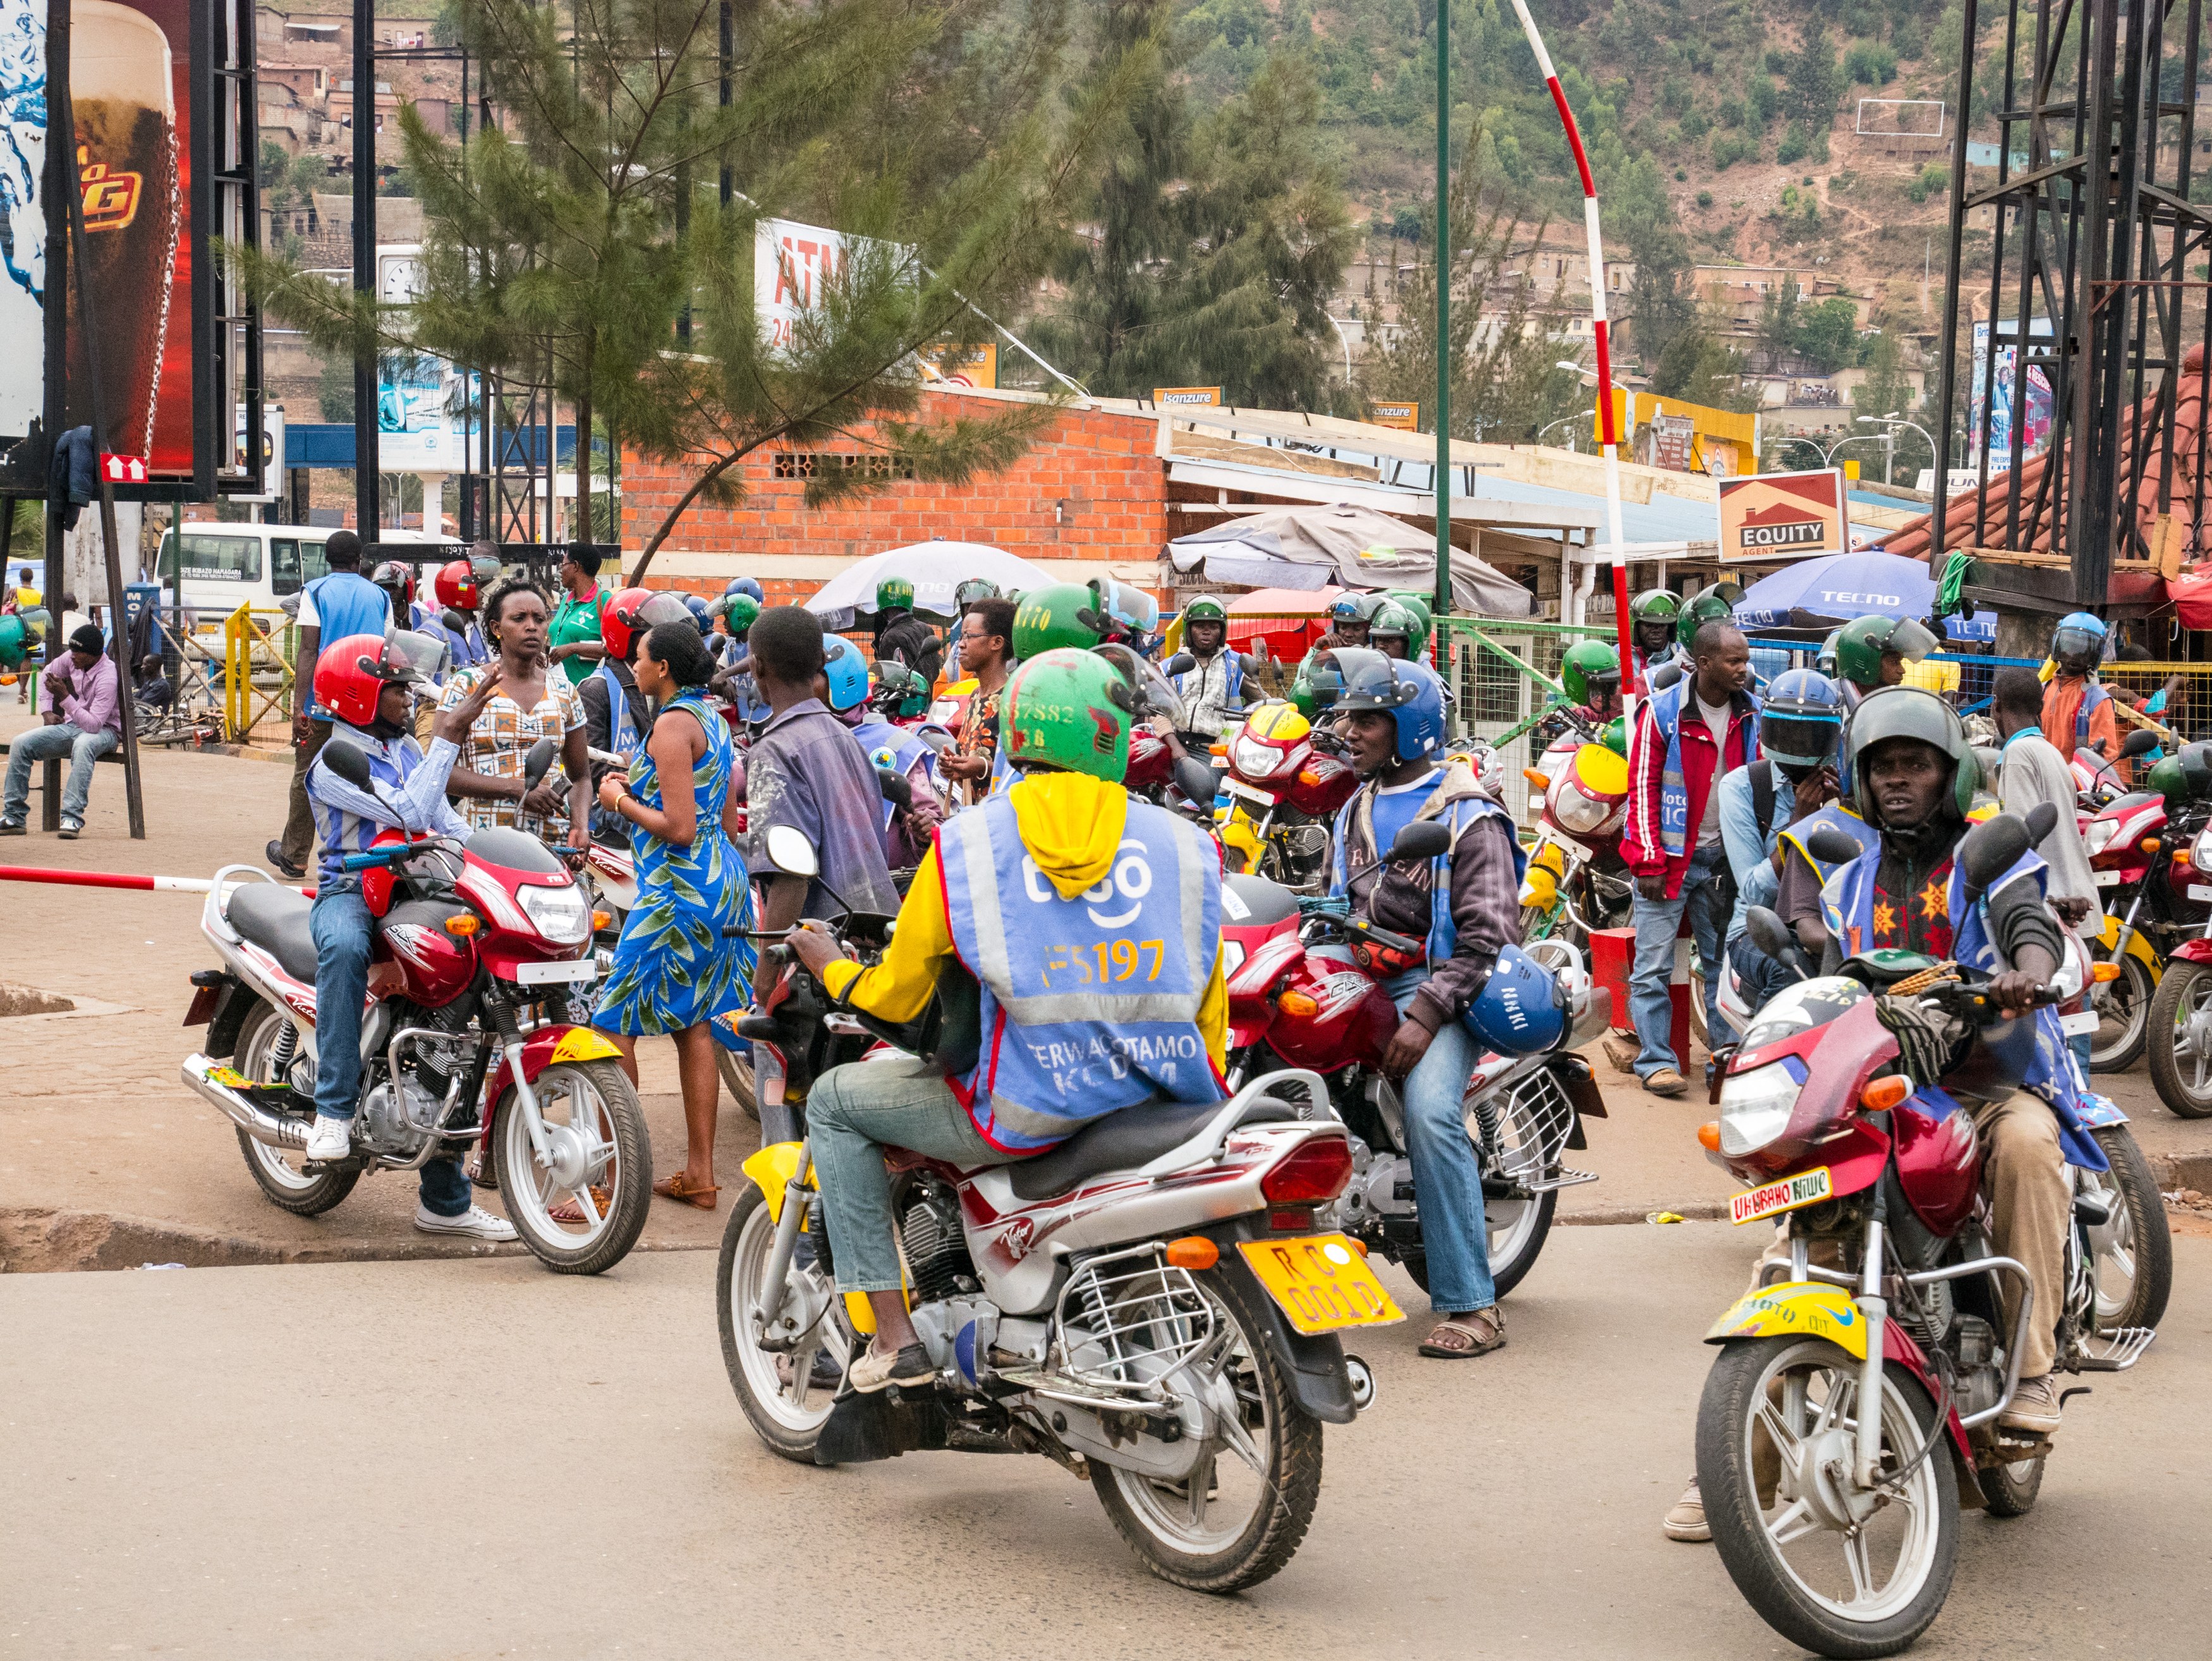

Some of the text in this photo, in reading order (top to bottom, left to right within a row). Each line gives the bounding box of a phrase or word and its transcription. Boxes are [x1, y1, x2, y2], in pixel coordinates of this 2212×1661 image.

[775, 236, 851, 311] ATM
[1163, 392, 1212, 404] Isanzure
[1743, 523, 1822, 545] EQUITY
[1742, 547, 1775, 556] AGENT
[1820, 590, 1900, 605] TECNO
[1583, 788, 1595, 796] TVS
[594, 856, 623, 876] Victor
[387, 925, 417, 954] GLX
[1330, 978, 1366, 998] GLX
[1735, 1052, 1758, 1068] TVS
[1809, 1315, 1830, 1334] CITY
